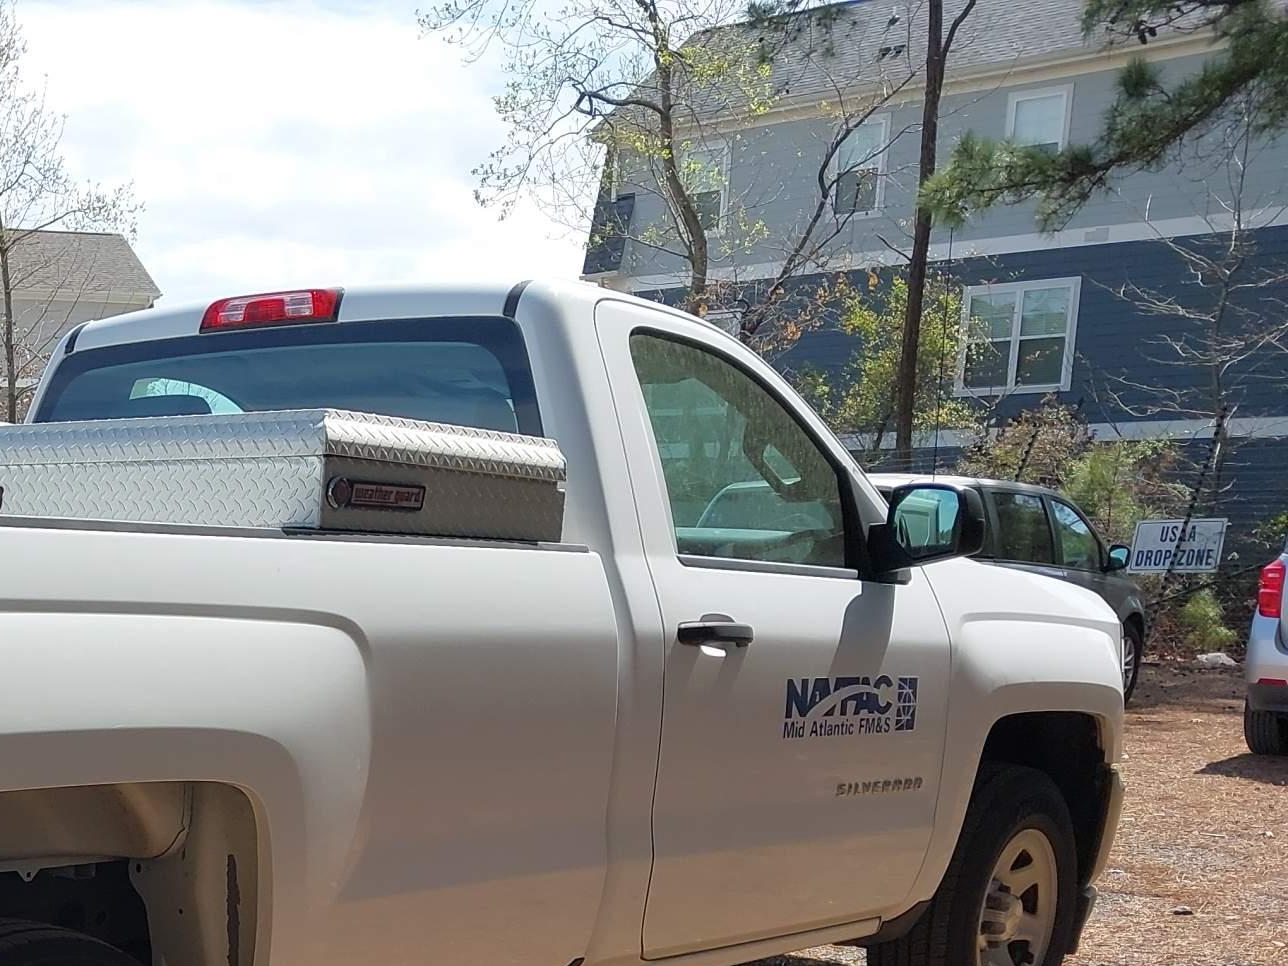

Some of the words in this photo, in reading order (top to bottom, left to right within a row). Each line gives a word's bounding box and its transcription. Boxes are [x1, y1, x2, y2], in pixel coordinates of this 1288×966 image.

[355, 486, 394, 501] weather
[395, 490, 421, 504] guard
[1135, 549, 1172, 567] DROP
[1176, 548, 1214, 567] ZONE
[783, 721, 806, 739] Mid
[809, 719, 854, 737] Atlantic
[858, 717, 891, 735] FM&S
[835, 776, 923, 797] SILVERADO
